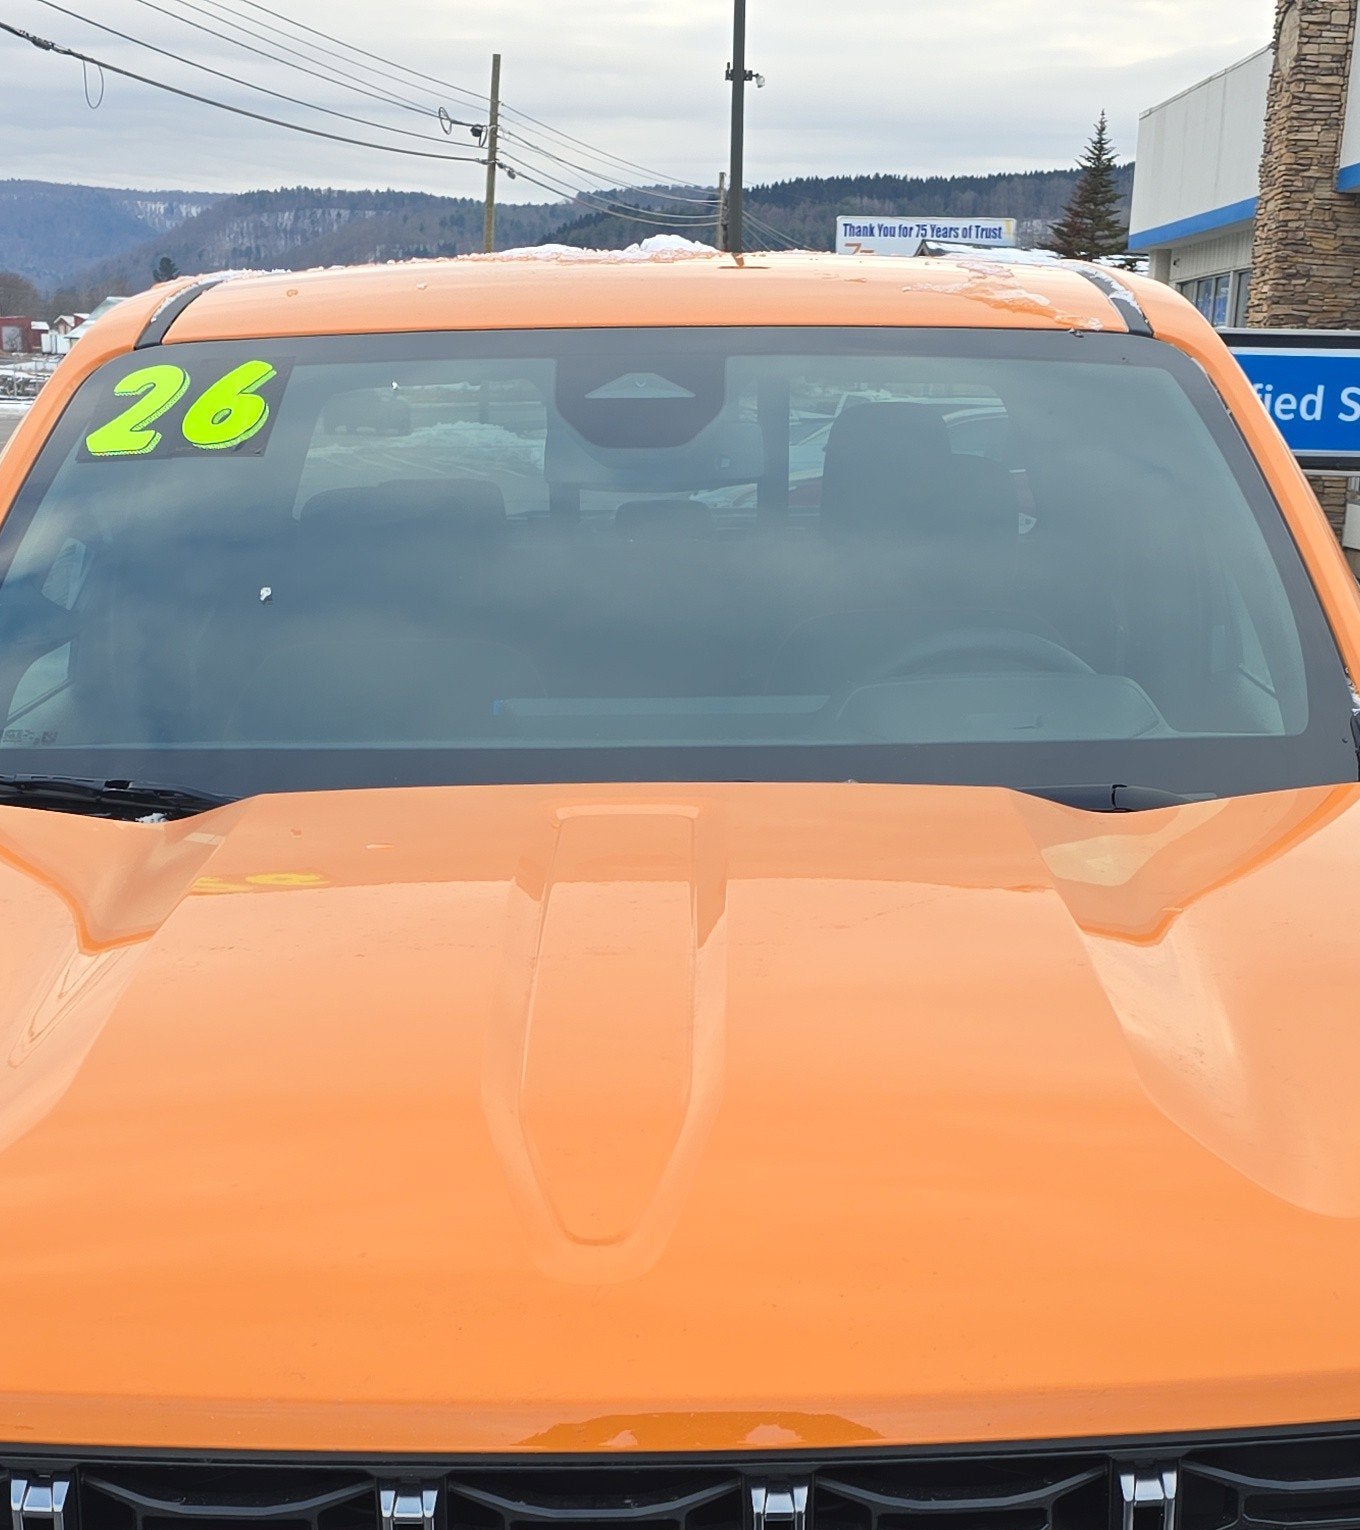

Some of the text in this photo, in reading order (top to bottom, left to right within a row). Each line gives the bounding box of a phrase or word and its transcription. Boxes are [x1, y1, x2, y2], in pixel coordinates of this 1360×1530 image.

[843, 223, 1002, 239] Thank You for 75 Years of Trust
[85, 360, 277, 456] 26
